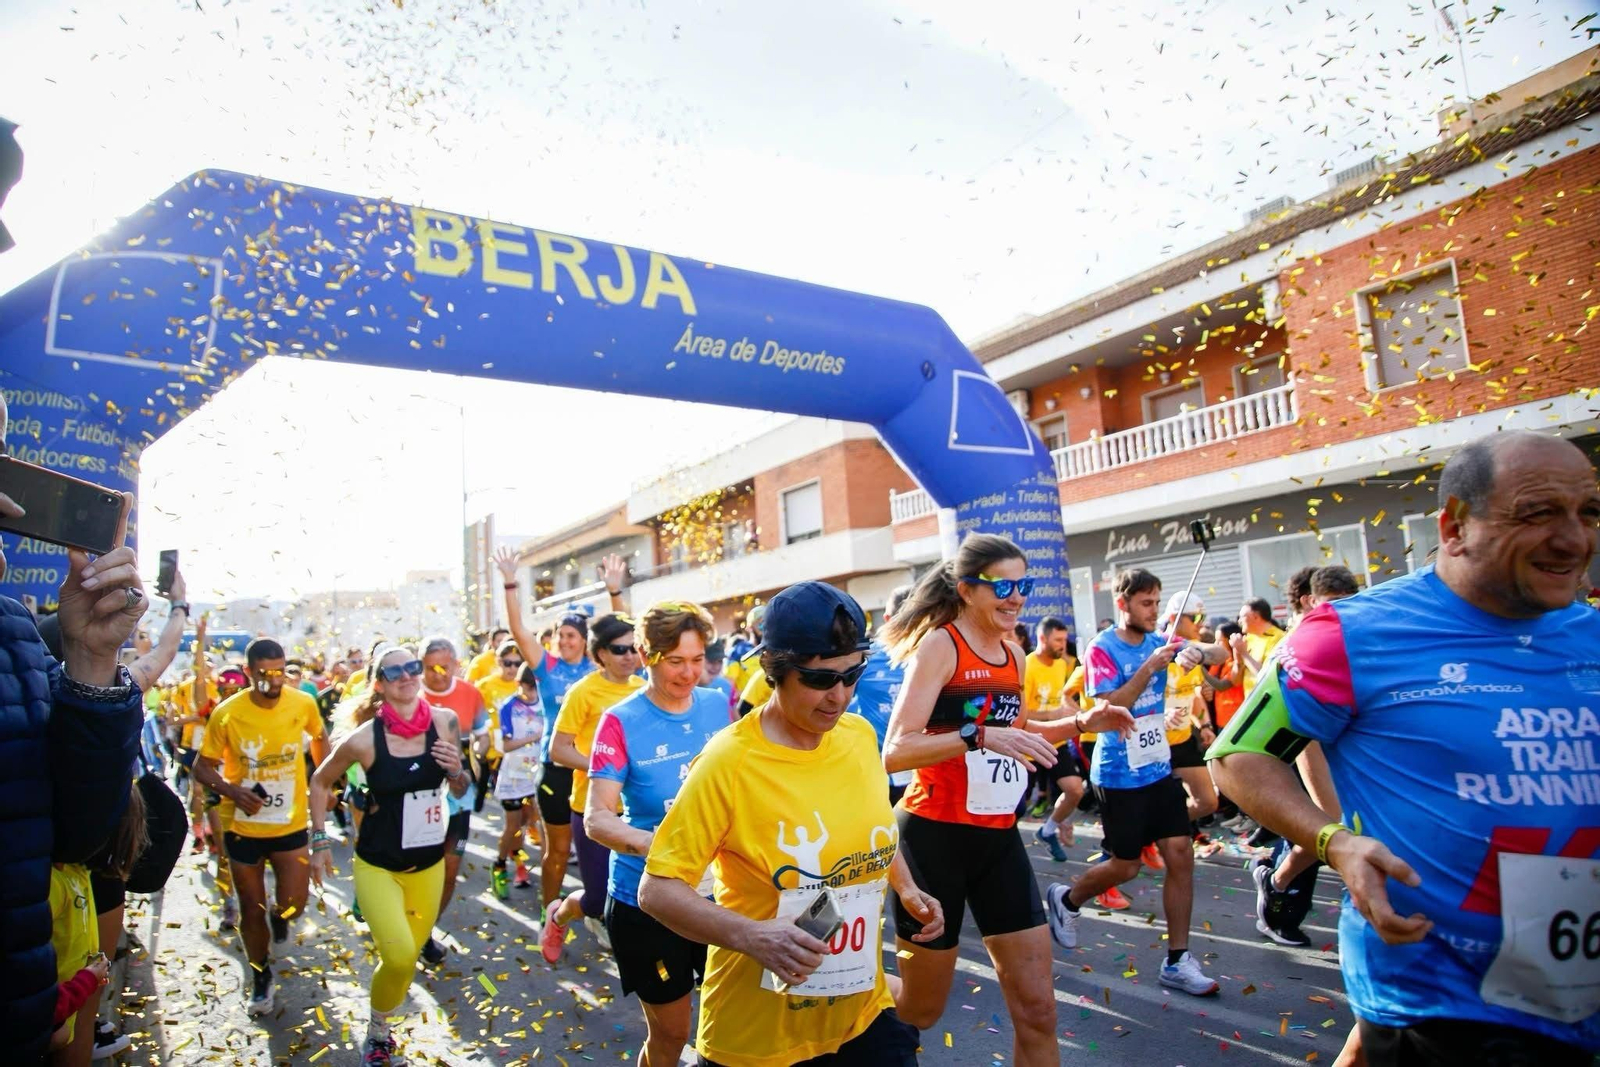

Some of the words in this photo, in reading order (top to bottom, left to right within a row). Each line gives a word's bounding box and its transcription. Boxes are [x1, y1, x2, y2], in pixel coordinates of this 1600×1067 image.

[410, 205, 698, 316] BERJA
[674, 322, 724, 358] Área
[730, 336, 757, 361] de
[760, 339, 846, 375] Deportes
[1104, 530, 1150, 562] Lina
[1388, 683, 1525, 702] TecnoMendoza
[1139, 728, 1162, 748] 585
[1493, 706, 1600, 738] ADRA
[987, 758, 1019, 784] 781
[1501, 740, 1600, 772] TRAIL
[1455, 772, 1600, 806] RUNNI
